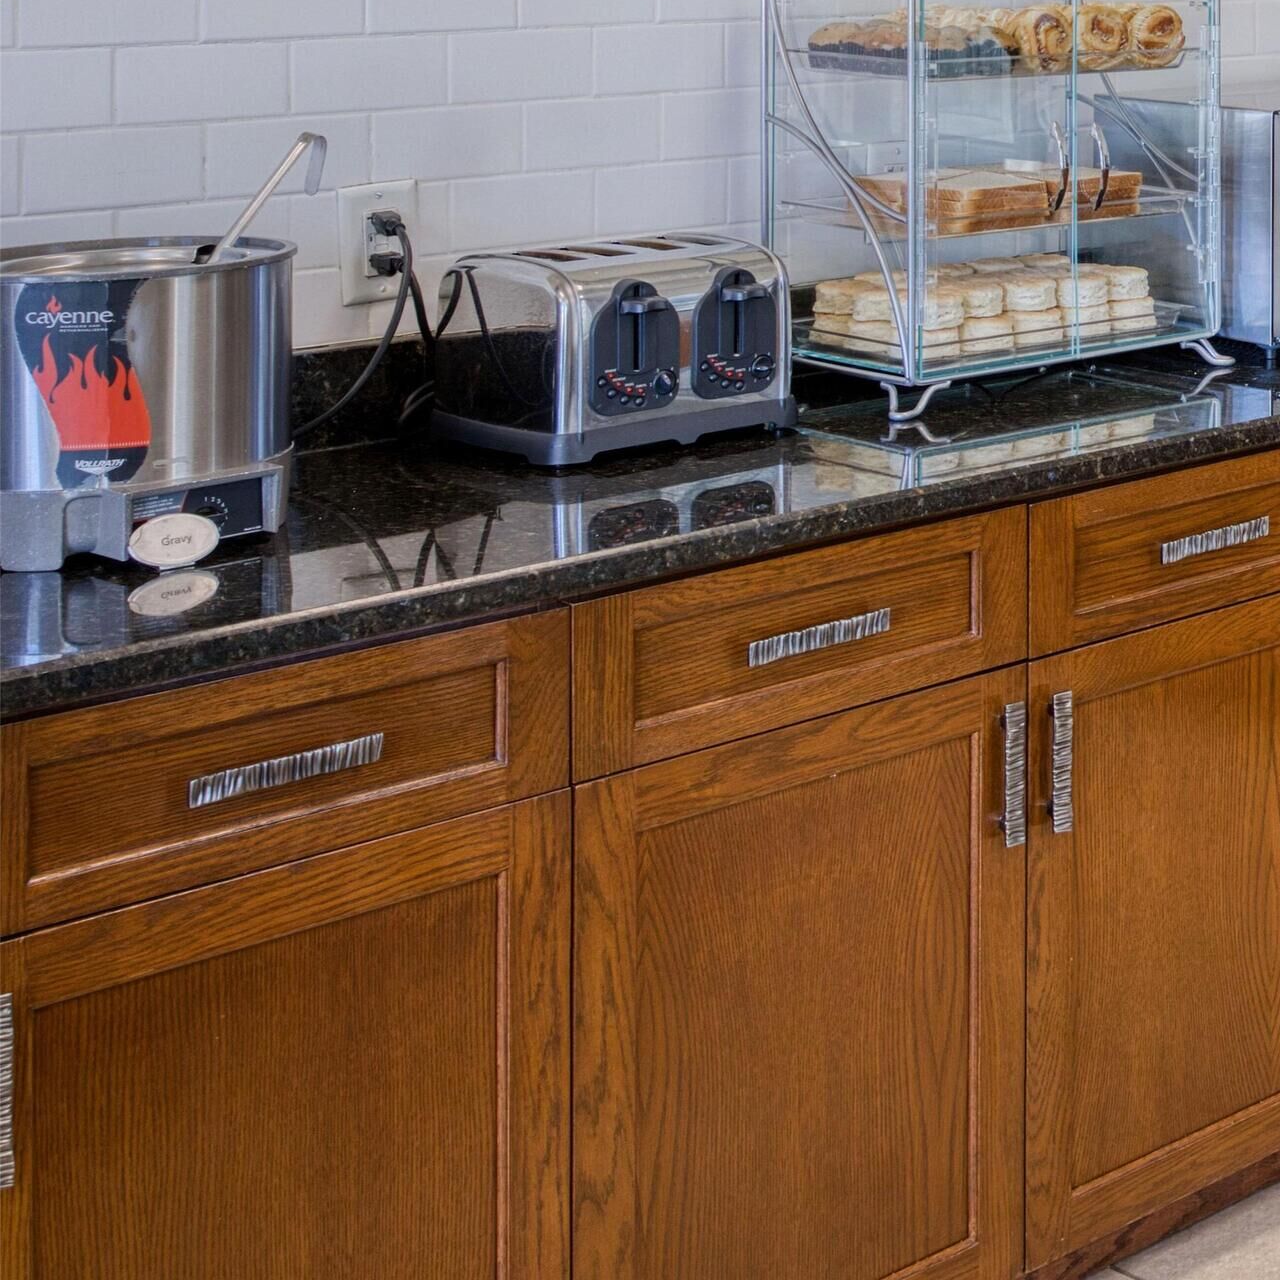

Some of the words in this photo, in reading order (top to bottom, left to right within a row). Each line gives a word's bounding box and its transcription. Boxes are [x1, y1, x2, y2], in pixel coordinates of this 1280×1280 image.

[25, 310, 114, 329] cayenne
[75, 458, 125, 468] VOLLRATH
[160, 534, 193, 547] Gravy
